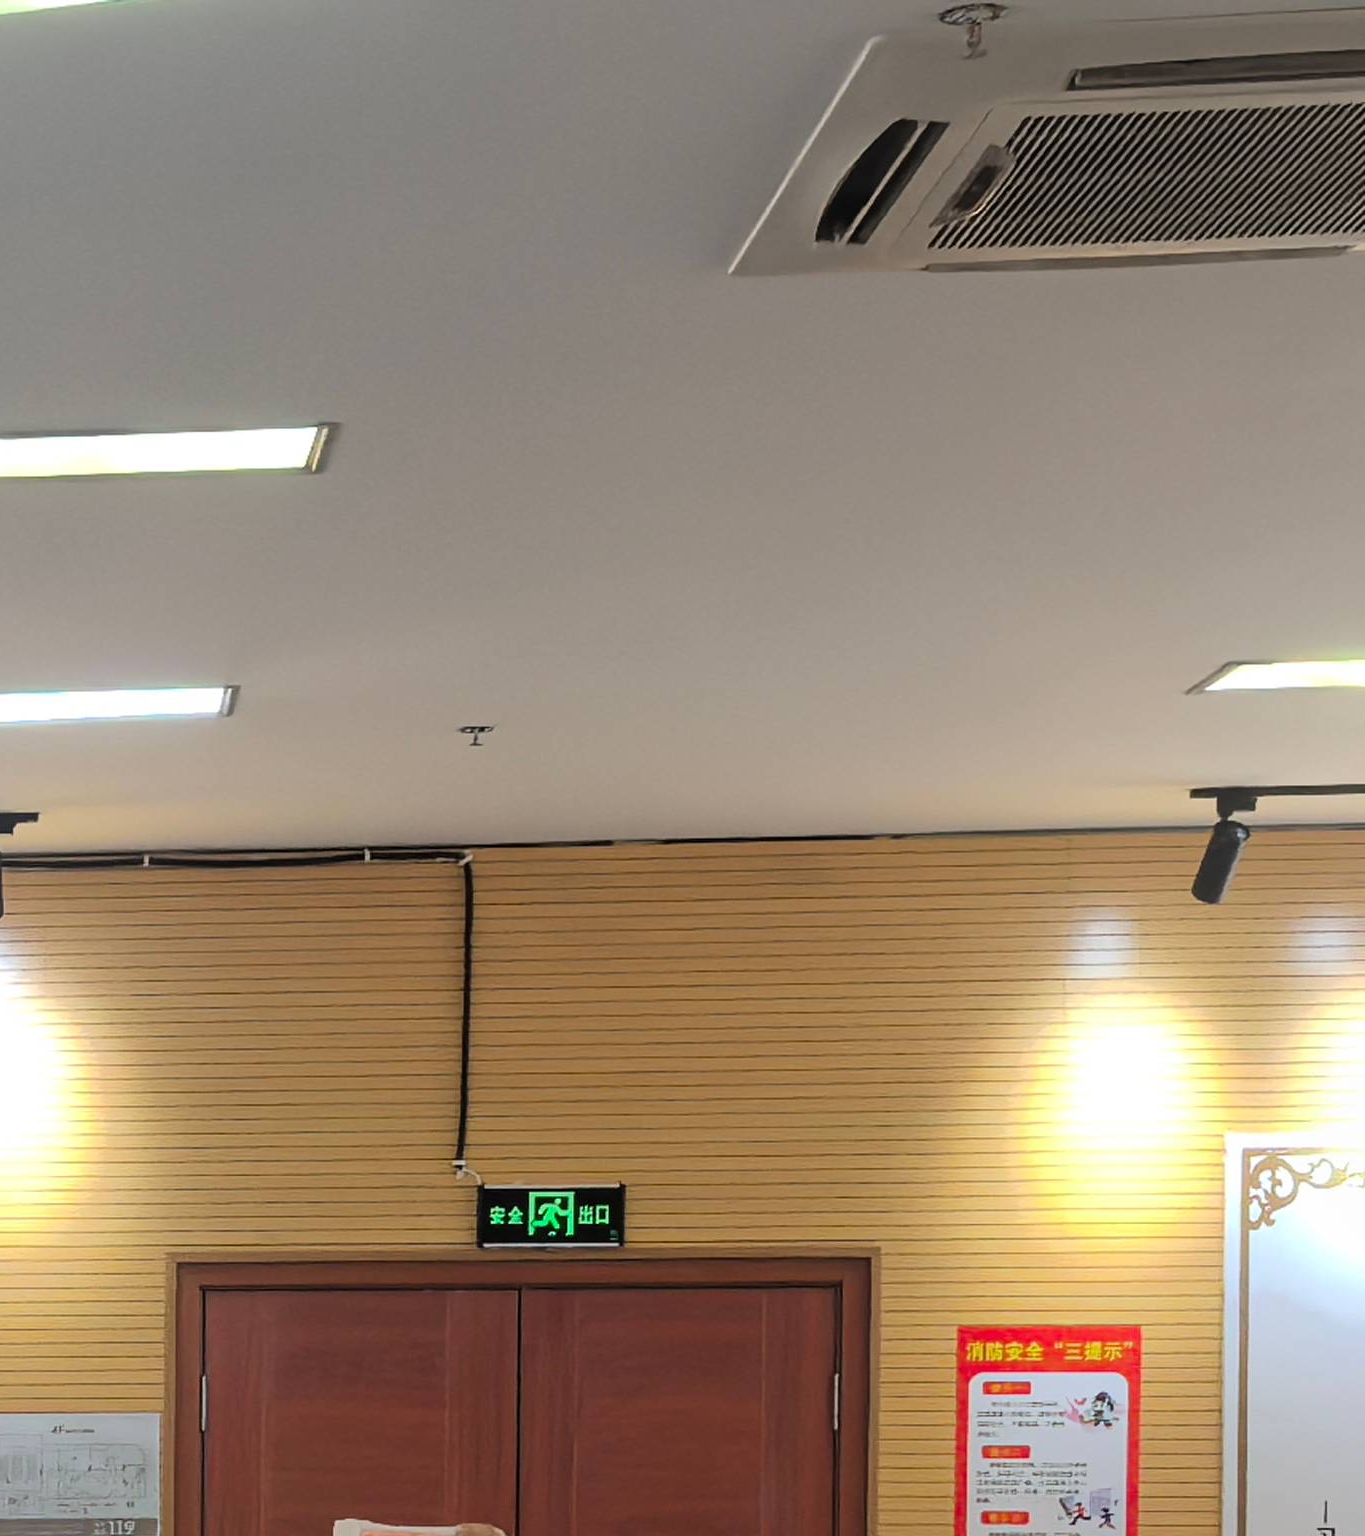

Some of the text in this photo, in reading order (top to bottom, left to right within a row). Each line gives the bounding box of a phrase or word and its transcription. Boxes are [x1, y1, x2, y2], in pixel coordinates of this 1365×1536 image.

[489, 1204, 610, 1225] 安全 出口
[966, 1341, 1045, 1362] 消防安全
